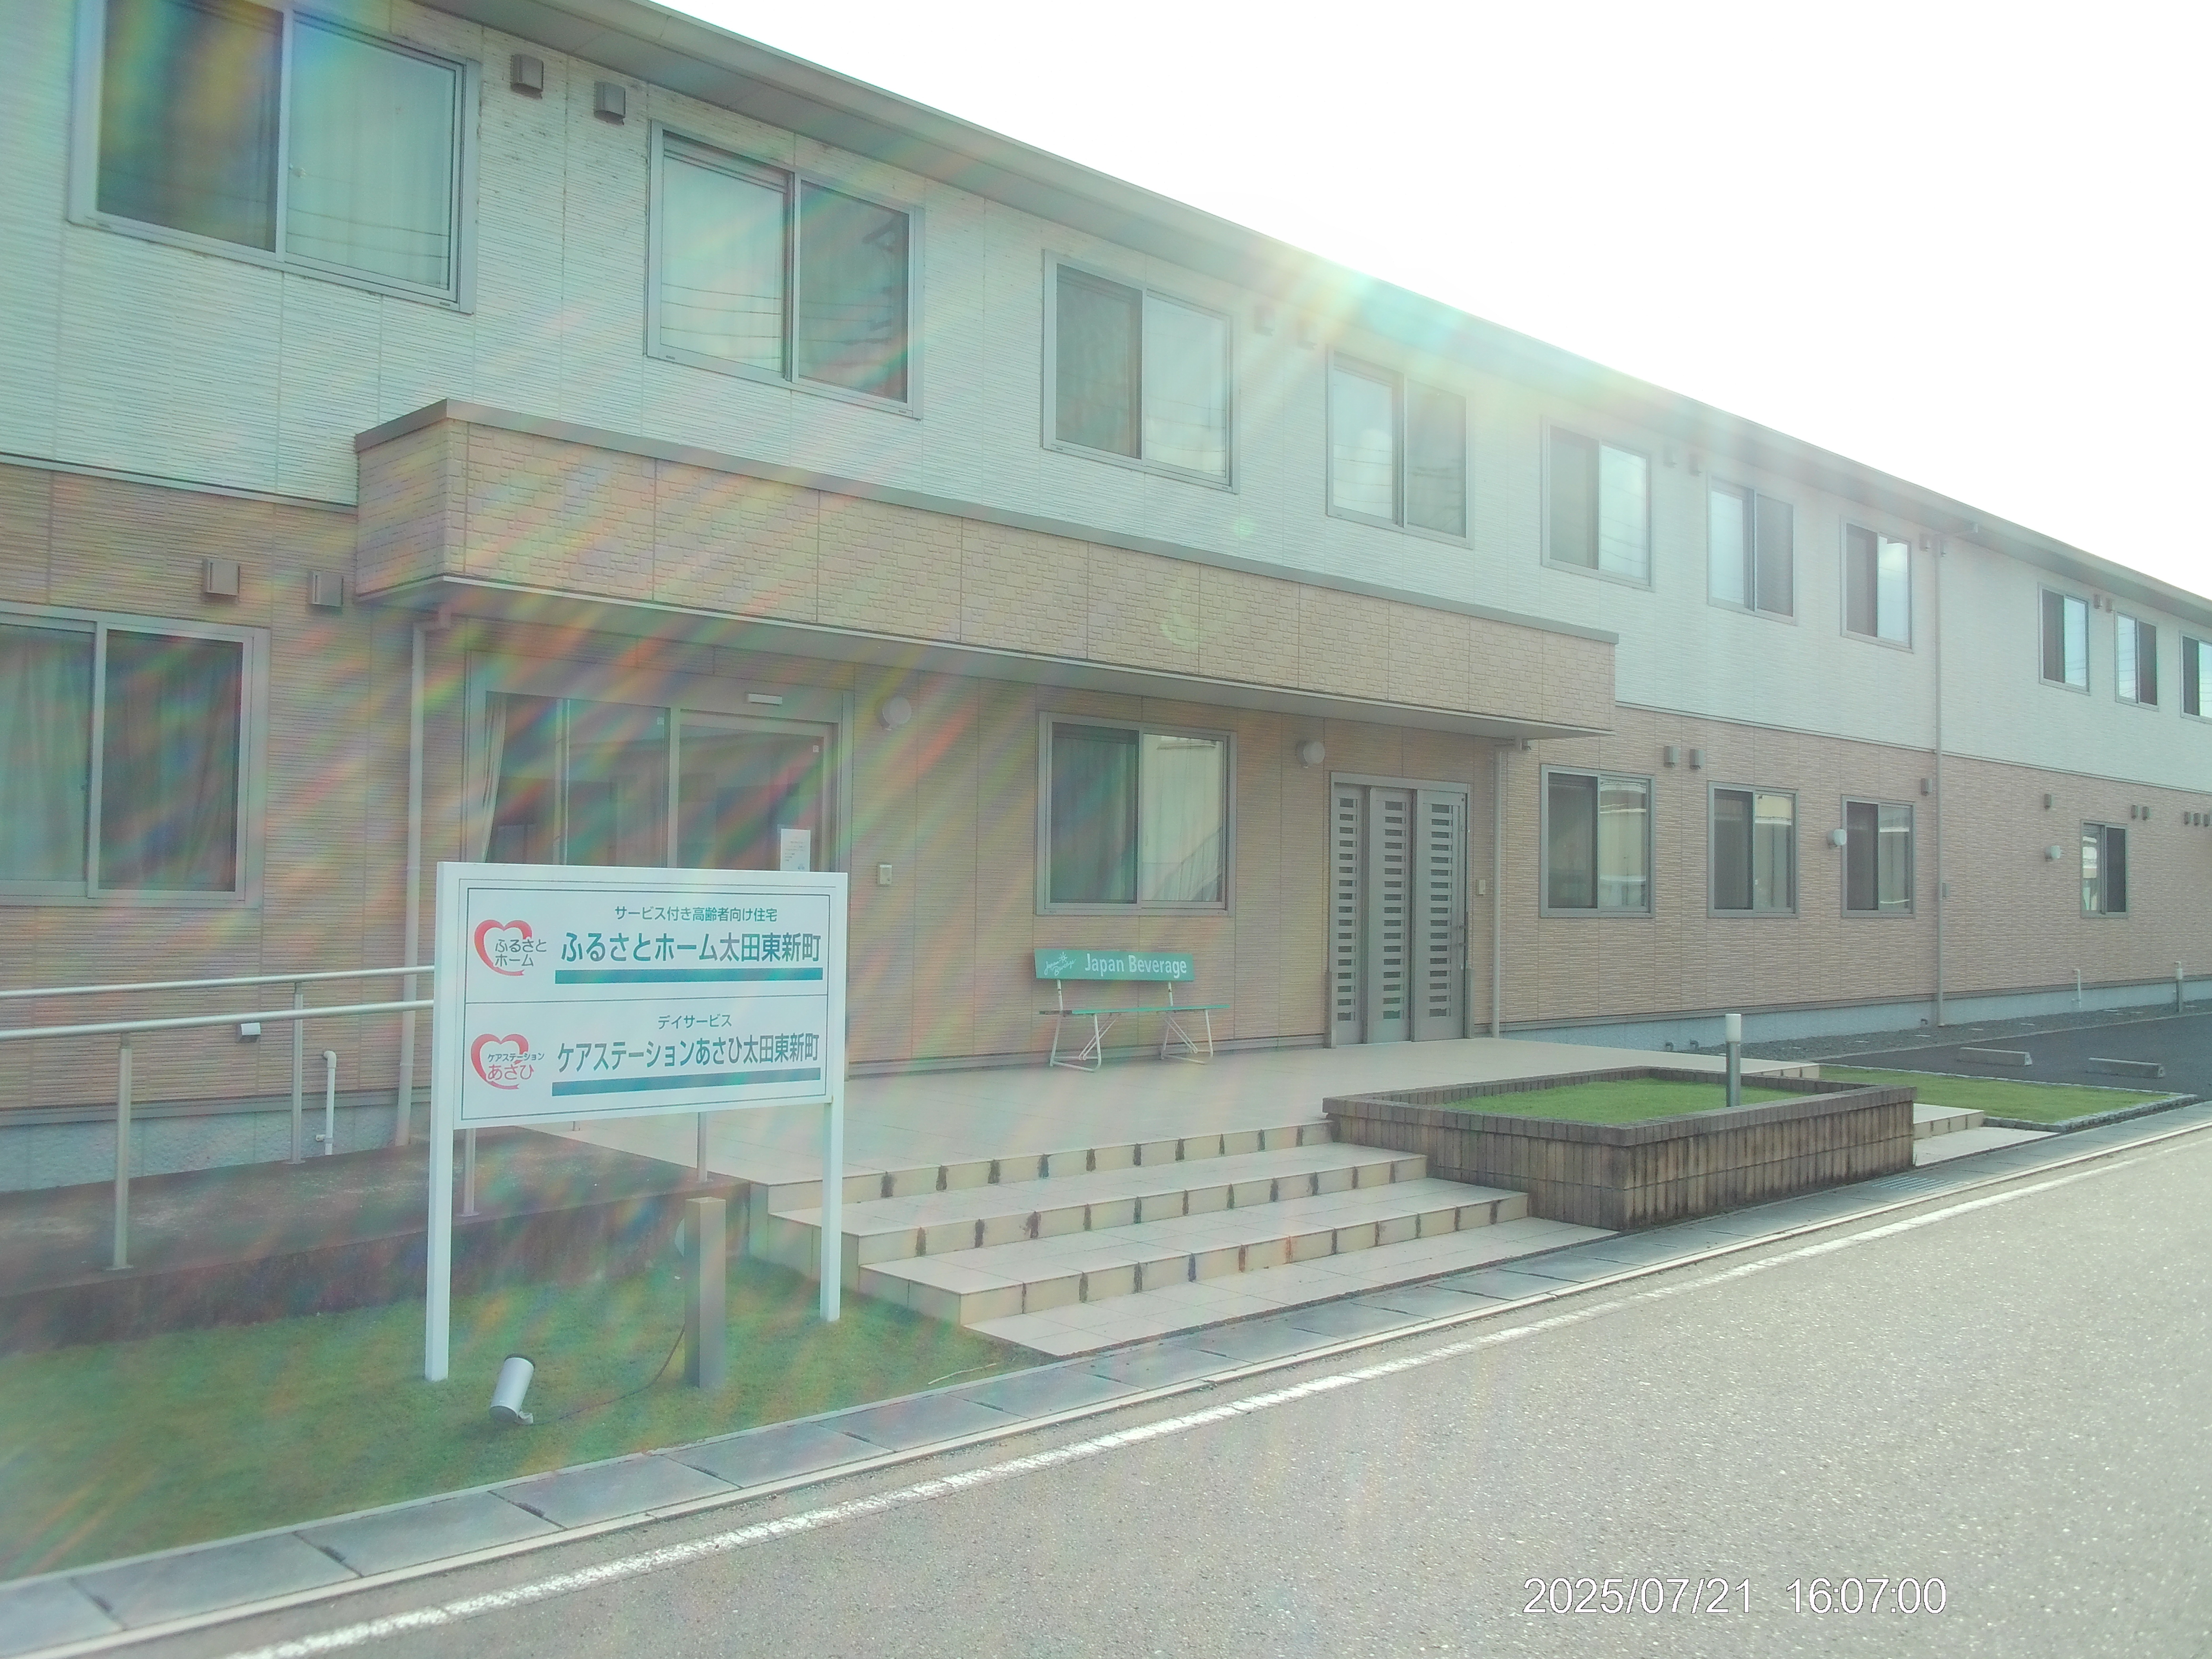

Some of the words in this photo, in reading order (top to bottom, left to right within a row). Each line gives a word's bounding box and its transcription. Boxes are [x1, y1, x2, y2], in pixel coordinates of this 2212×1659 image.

[615, 906, 777, 923] サービス付き高齢者向け住宅
[495, 939, 547, 952] ふるさと
[561, 932, 821, 963] ふるさとホーム太田東新町
[495, 954, 534, 967] ホーム
[1085, 953, 1124, 977] Japan
[1128, 954, 1187, 978] Beverage
[658, 1014, 732, 1029] デイサービス
[487, 1052, 545, 1062] ケアステーション
[557, 1033, 819, 1073] ケアステーションあさひ太田東新町
[488, 1064, 534, 1080] あさひ
